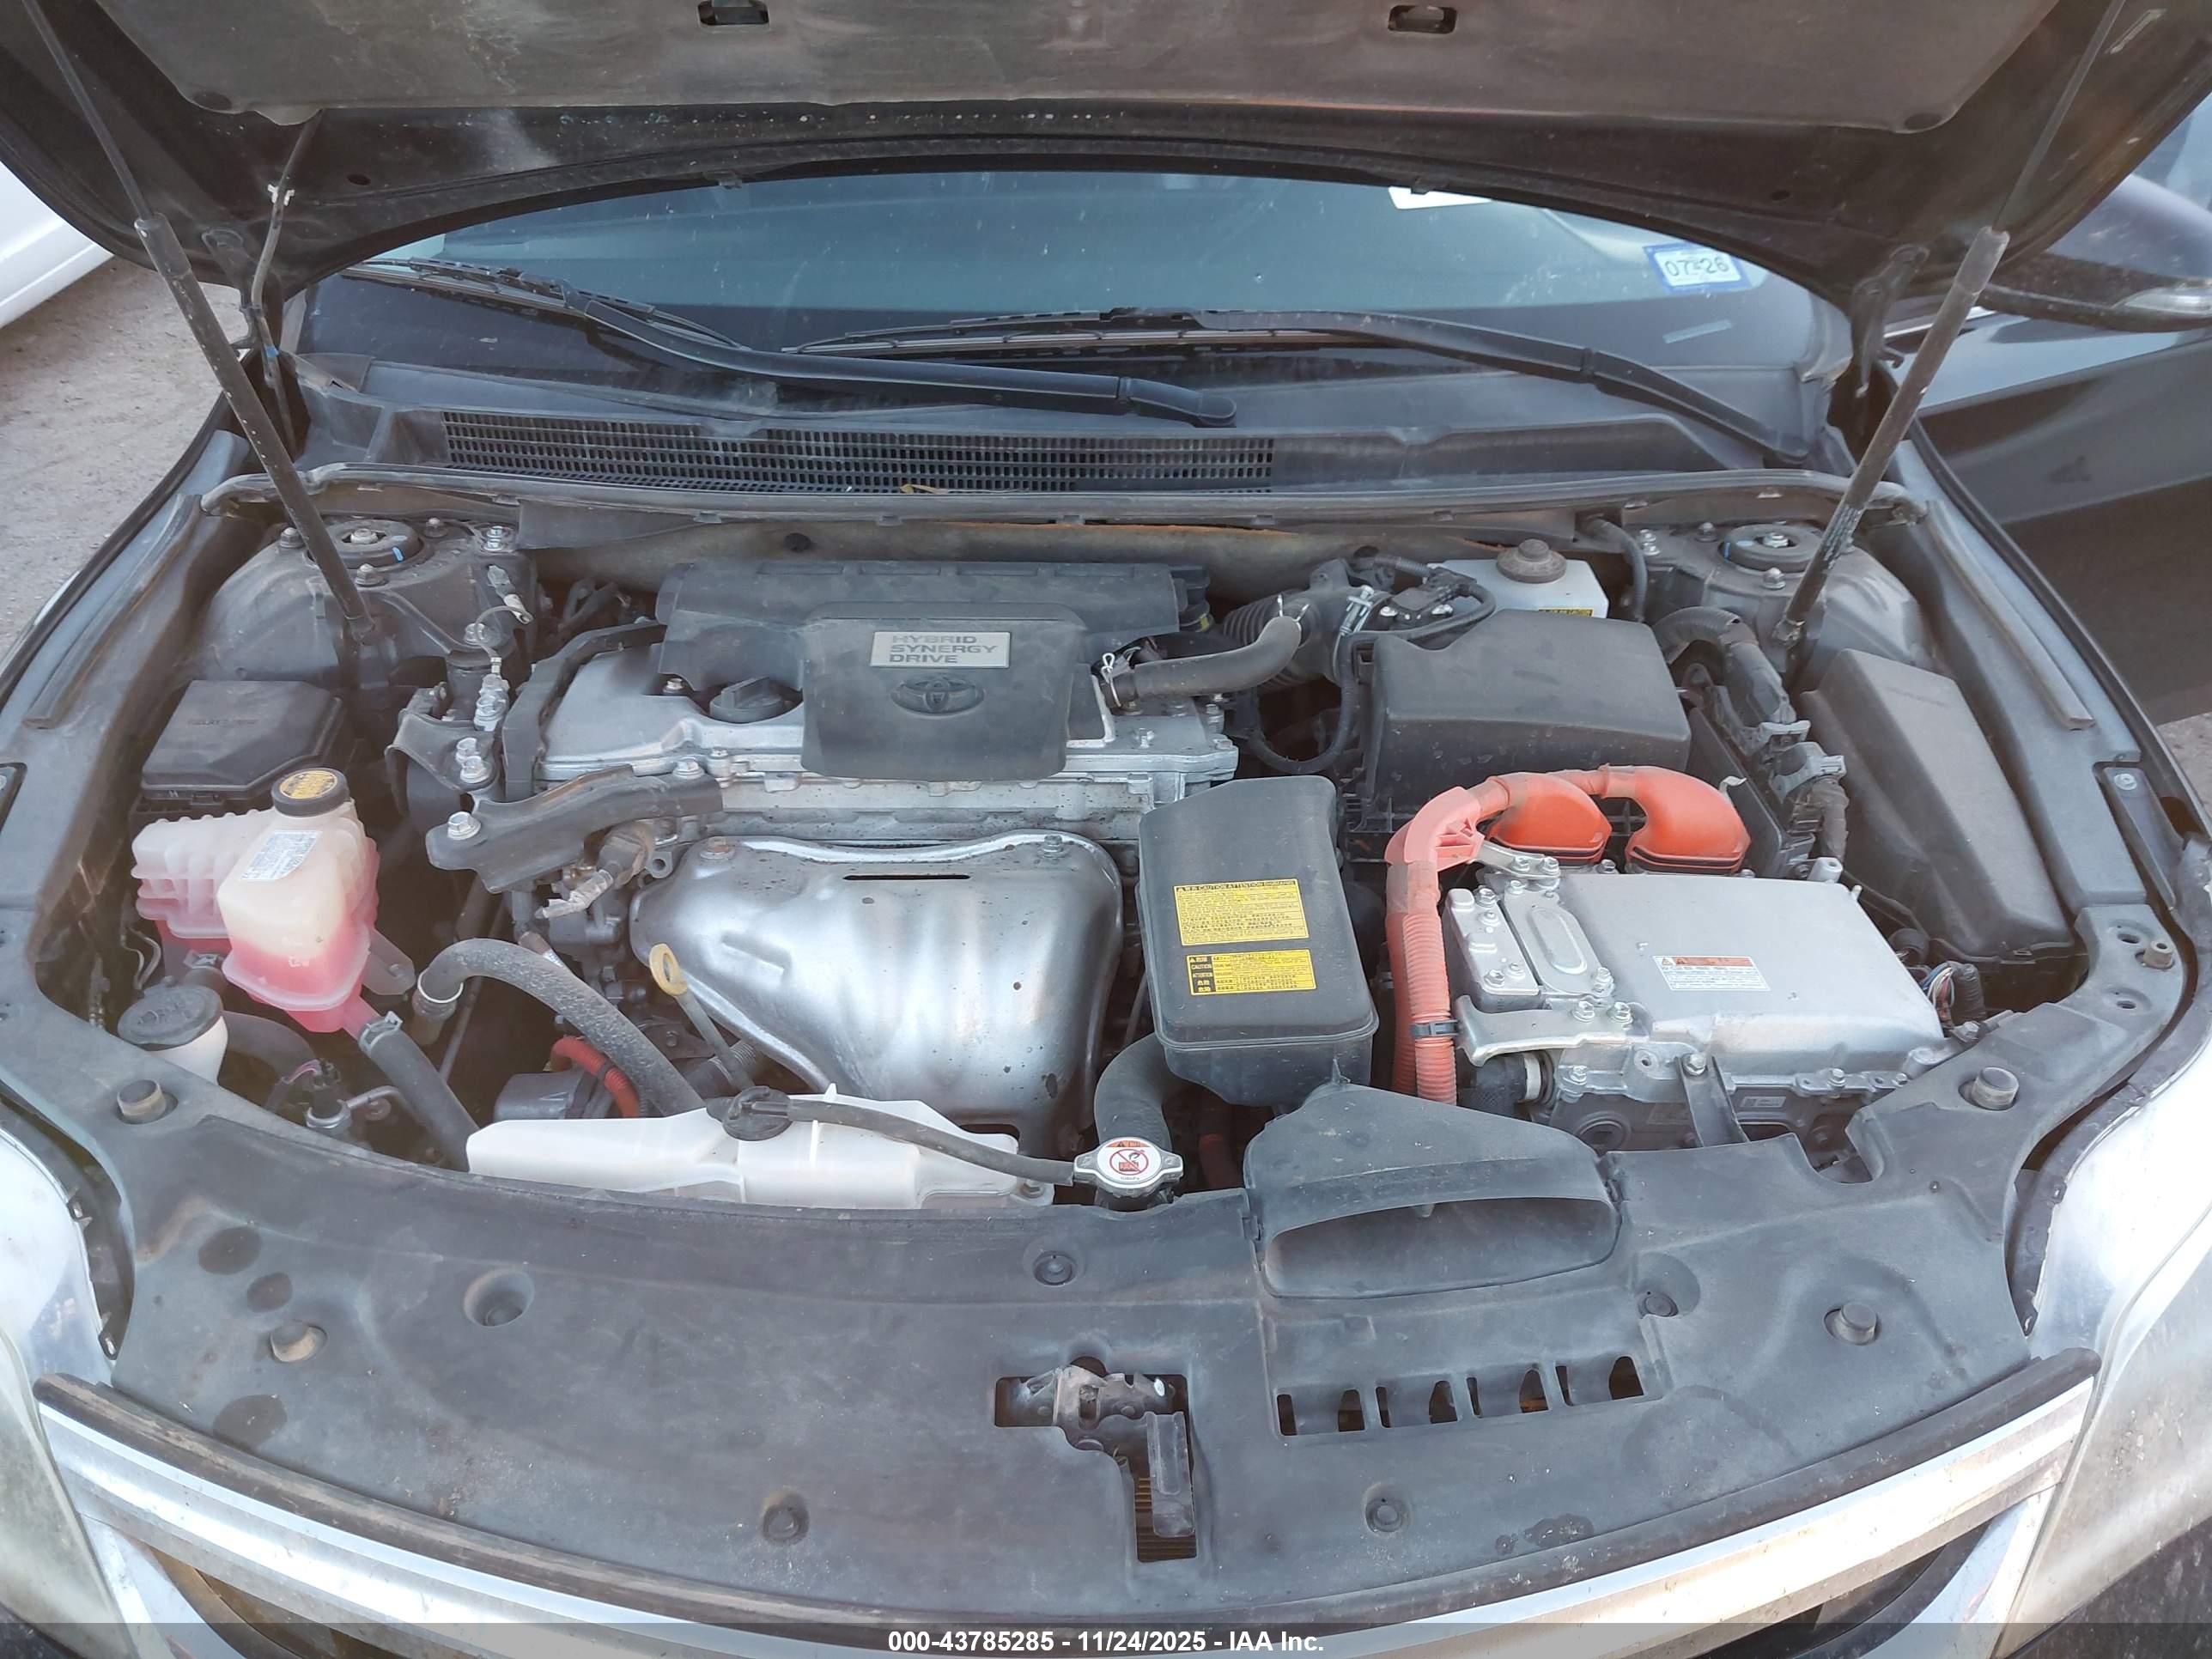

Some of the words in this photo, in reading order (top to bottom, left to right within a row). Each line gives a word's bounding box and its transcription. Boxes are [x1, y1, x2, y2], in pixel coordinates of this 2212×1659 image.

[892, 635, 977, 644] HYBRID
[890, 644, 999, 653] SYNERGY
[889, 653, 958, 664] DRIVE
